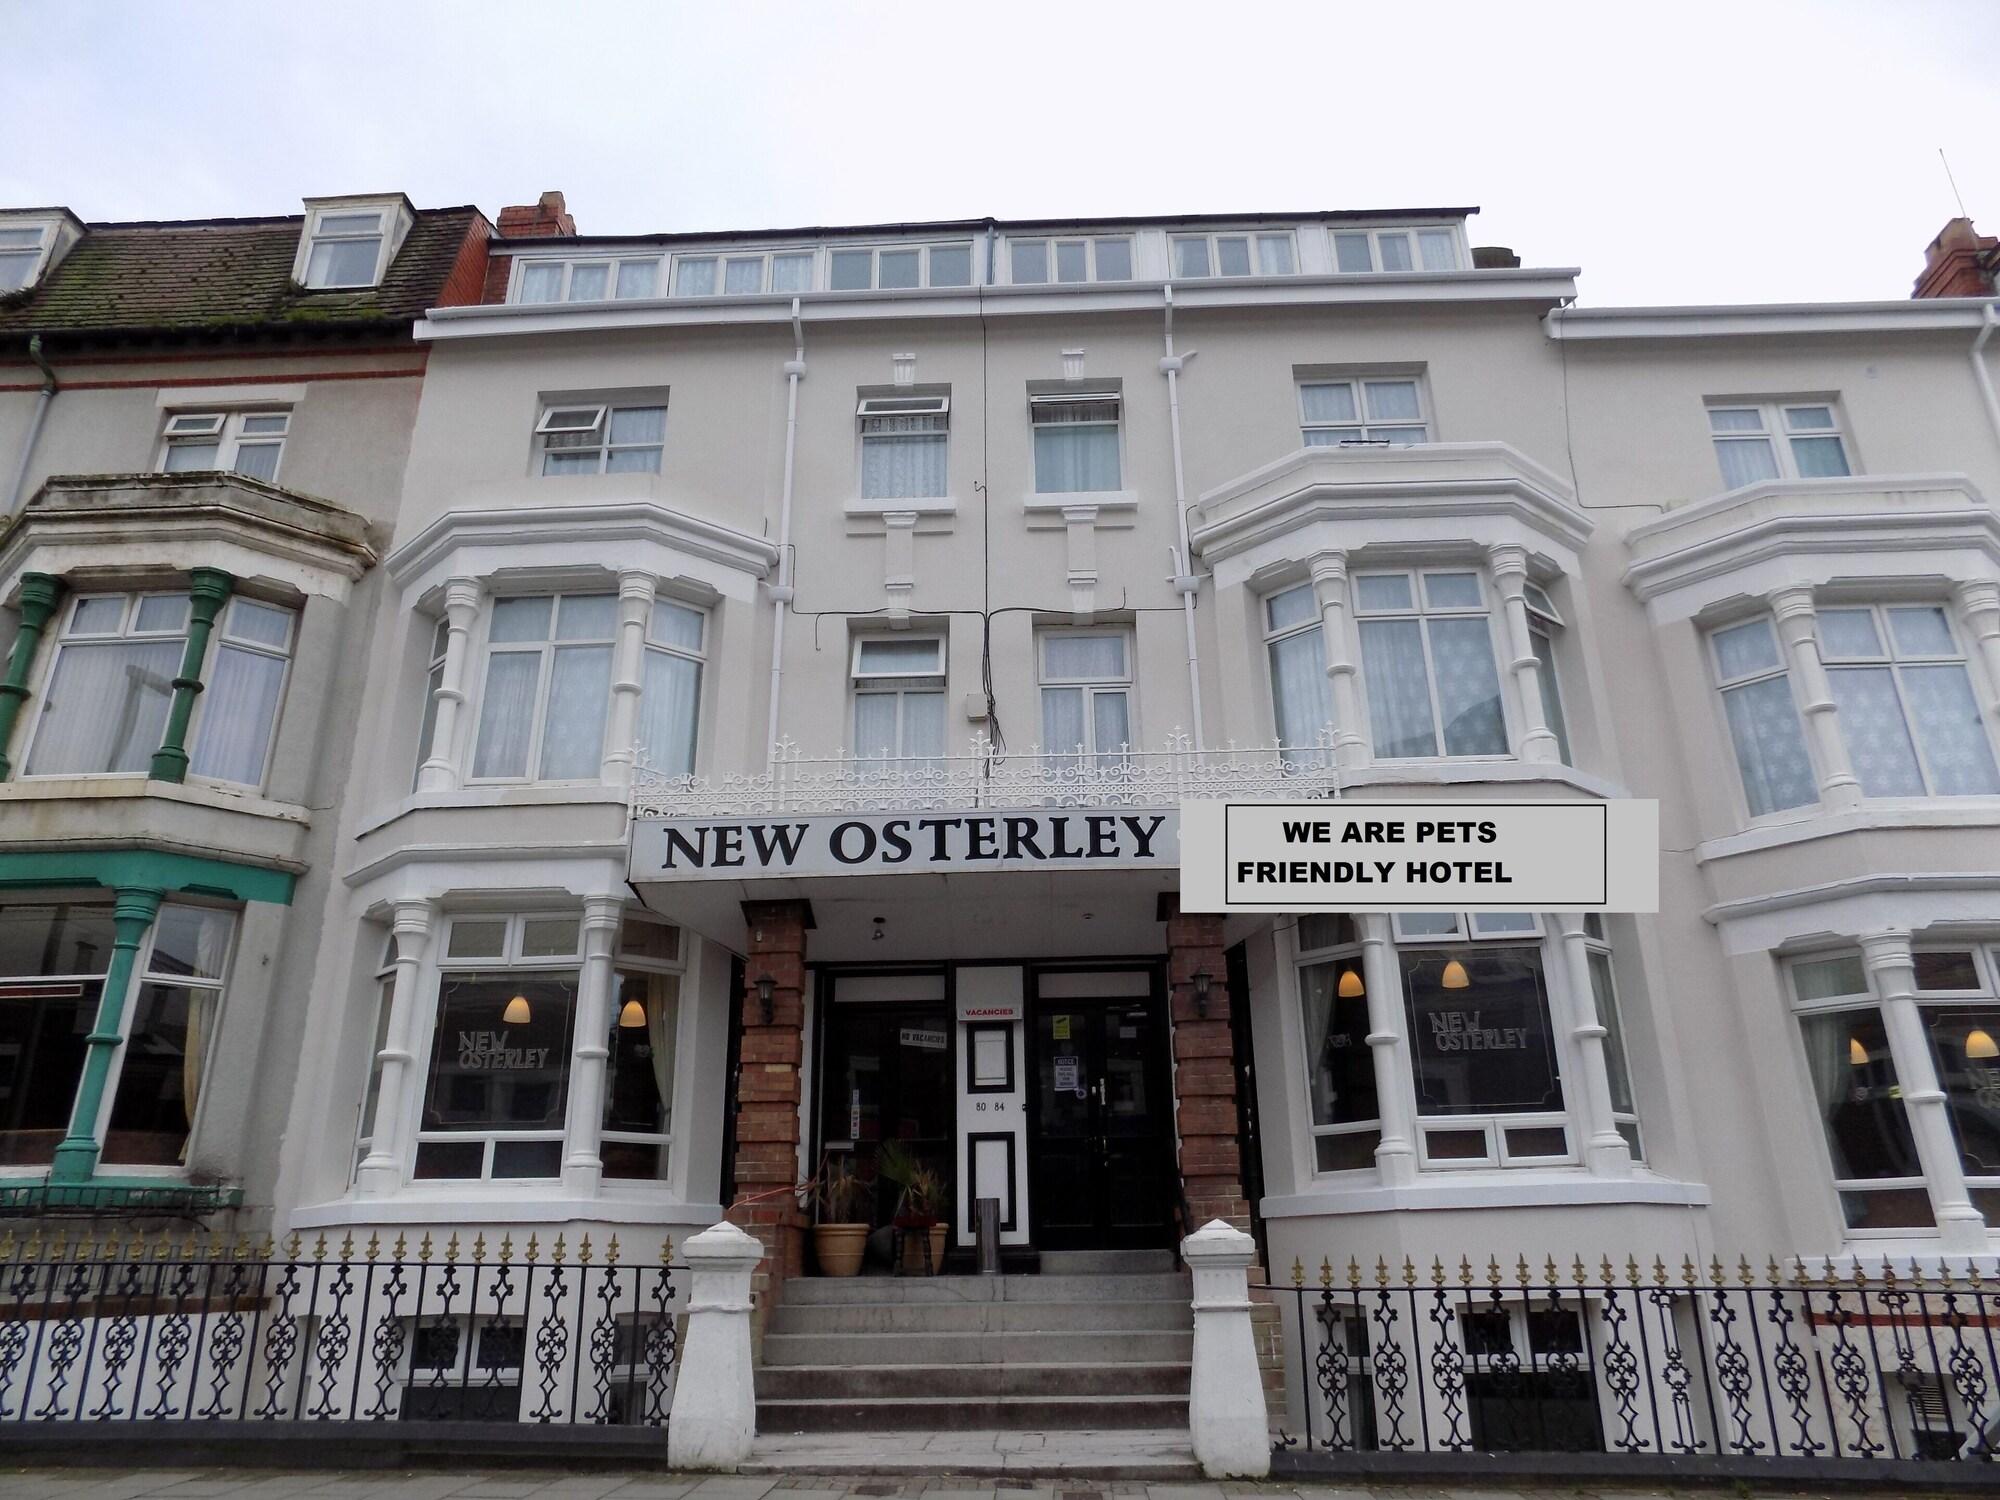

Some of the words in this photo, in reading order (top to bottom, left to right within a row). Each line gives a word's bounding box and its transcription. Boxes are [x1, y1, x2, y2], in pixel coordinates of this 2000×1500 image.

[662, 823, 809, 868] NEW
[829, 815, 1166, 864] OSTERLEY
[965, 1008, 1014, 1016] VACANCIES
[1428, 1011, 1480, 1034] NEW
[458, 1030, 509, 1052] NEW
[901, 1032, 911, 1040] NO
[912, 1033, 945, 1044] VACANCIES
[1436, 1028, 1527, 1051] OSTERLEY
[459, 1048, 550, 1070] OSTERLEY
[975, 1102, 986, 1112] 80
[994, 1102, 1005, 1112] 84
